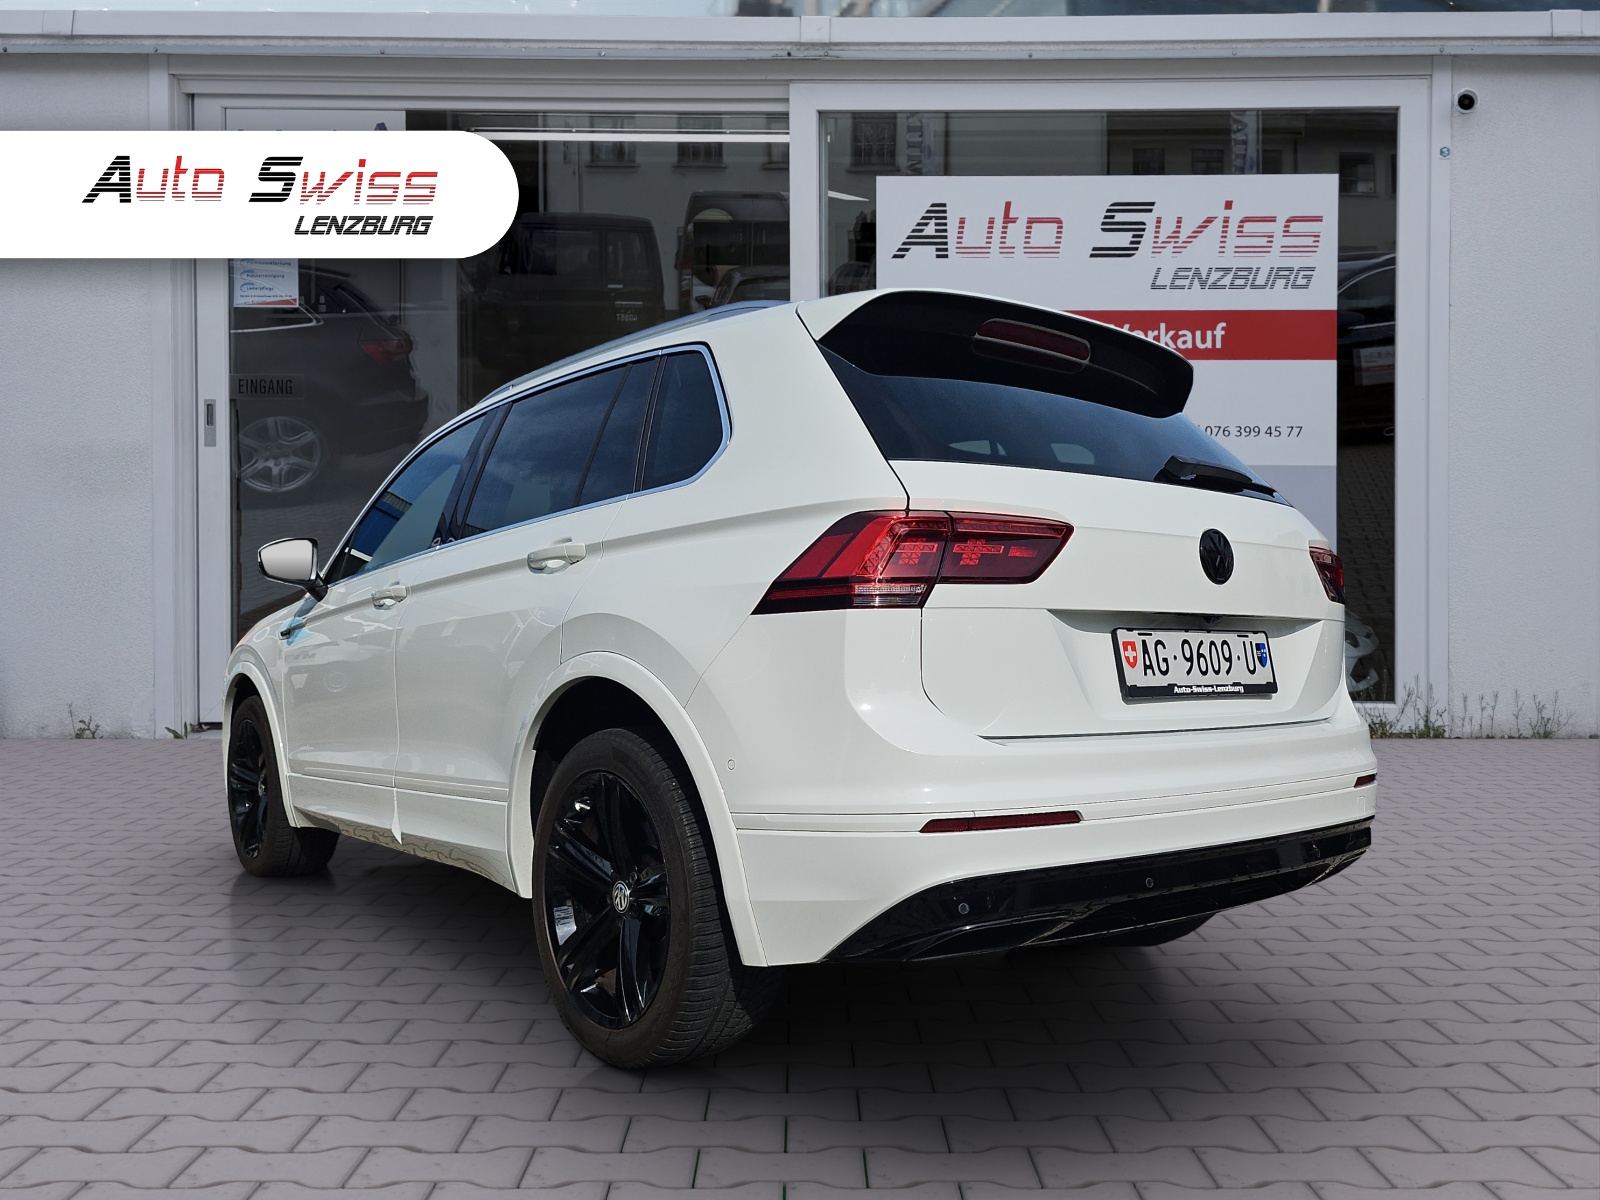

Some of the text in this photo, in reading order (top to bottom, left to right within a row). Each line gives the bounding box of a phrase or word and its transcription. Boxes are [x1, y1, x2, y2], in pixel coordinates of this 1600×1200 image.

[891, 200, 1324, 259] Auto Swiss
[1150, 267, 1317, 290] LENZBURG
[1110, 322, 1227, 349] rkauf
[238, 378, 293, 395] EINGANG
[1205, 425, 1303, 437] 076 399 45 77
[1173, 685, 1245, 694] Auto-Swiss-Lenzburg
